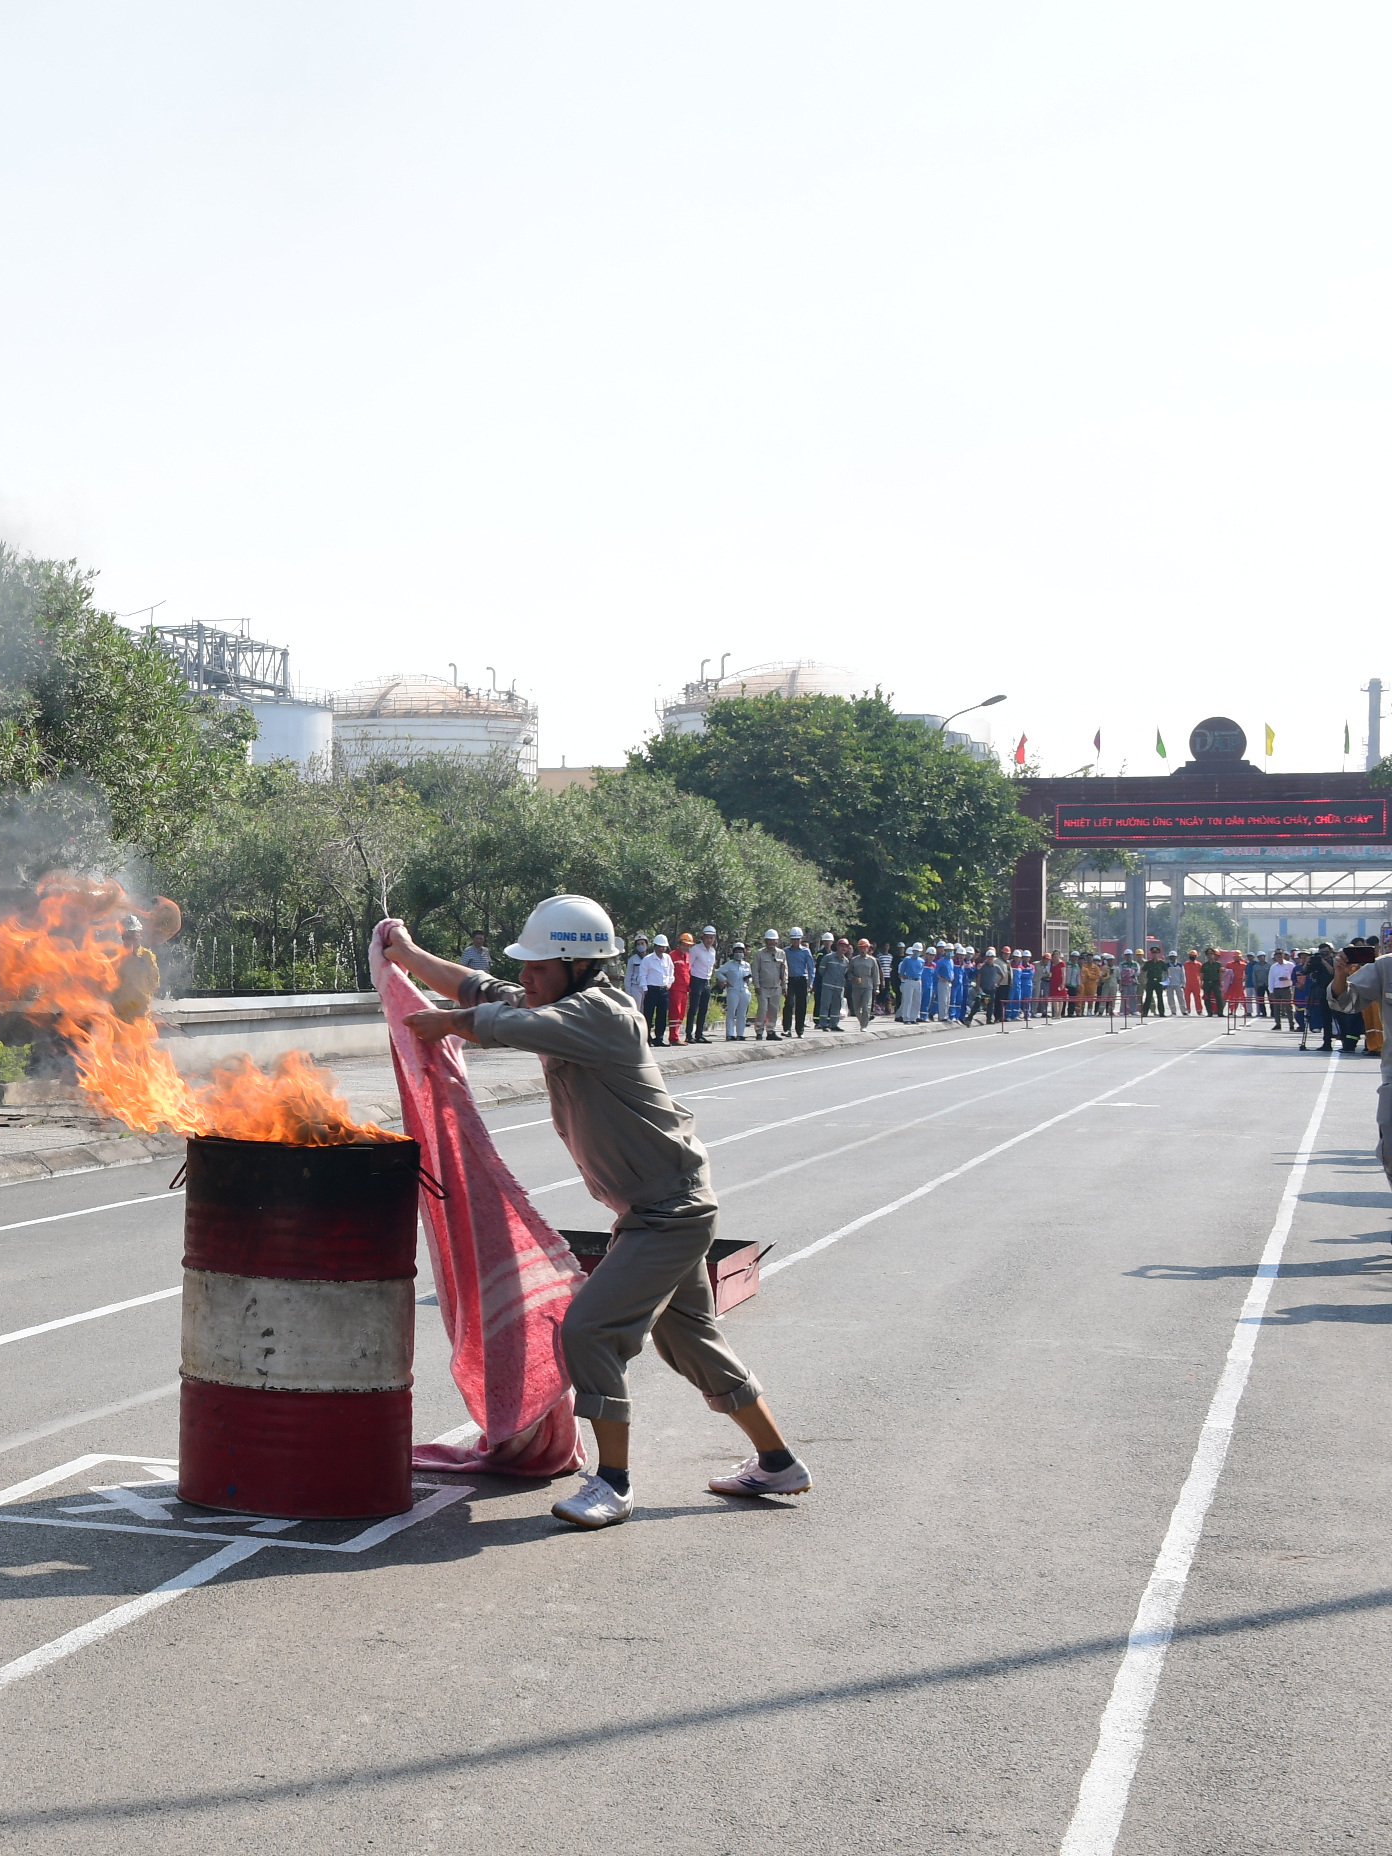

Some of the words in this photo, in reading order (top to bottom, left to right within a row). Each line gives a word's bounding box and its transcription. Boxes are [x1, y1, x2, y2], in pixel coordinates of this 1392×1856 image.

[550, 931, 577, 942] HONG
[580, 932, 593, 942] HA
[595, 932, 609, 942] GAS
